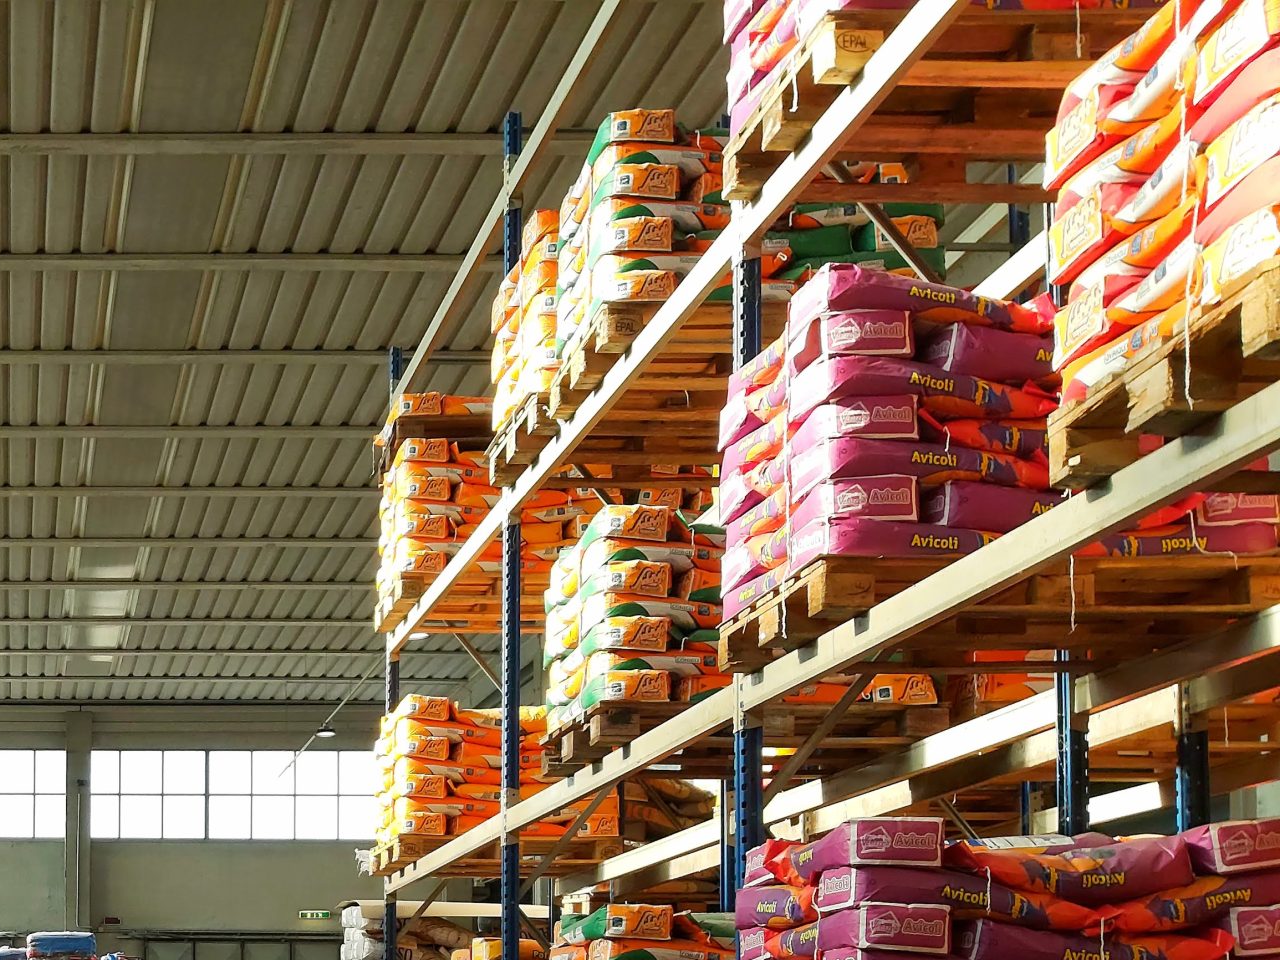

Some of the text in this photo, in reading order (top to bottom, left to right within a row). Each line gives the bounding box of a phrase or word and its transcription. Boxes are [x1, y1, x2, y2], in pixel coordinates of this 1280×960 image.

[910, 286, 956, 303] Avicoli
[616, 321, 635, 332] EPAL
[865, 323, 902, 336] Avicoli
[909, 372, 954, 391] Avicoli
[873, 407, 911, 421] Avicoli
[911, 451, 957, 466] Avicoli
[871, 489, 909, 503] Avicoli
[911, 534, 959, 549] Avicoli
[1162, 536, 1207, 552] Avicoli
[896, 834, 936, 848] Avicoli
[1082, 871, 1125, 888] Avicoli
[941, 884, 988, 906] Avicoli
[1206, 888, 1251, 909] Avicoli
[903, 921, 942, 934] Avicoli
